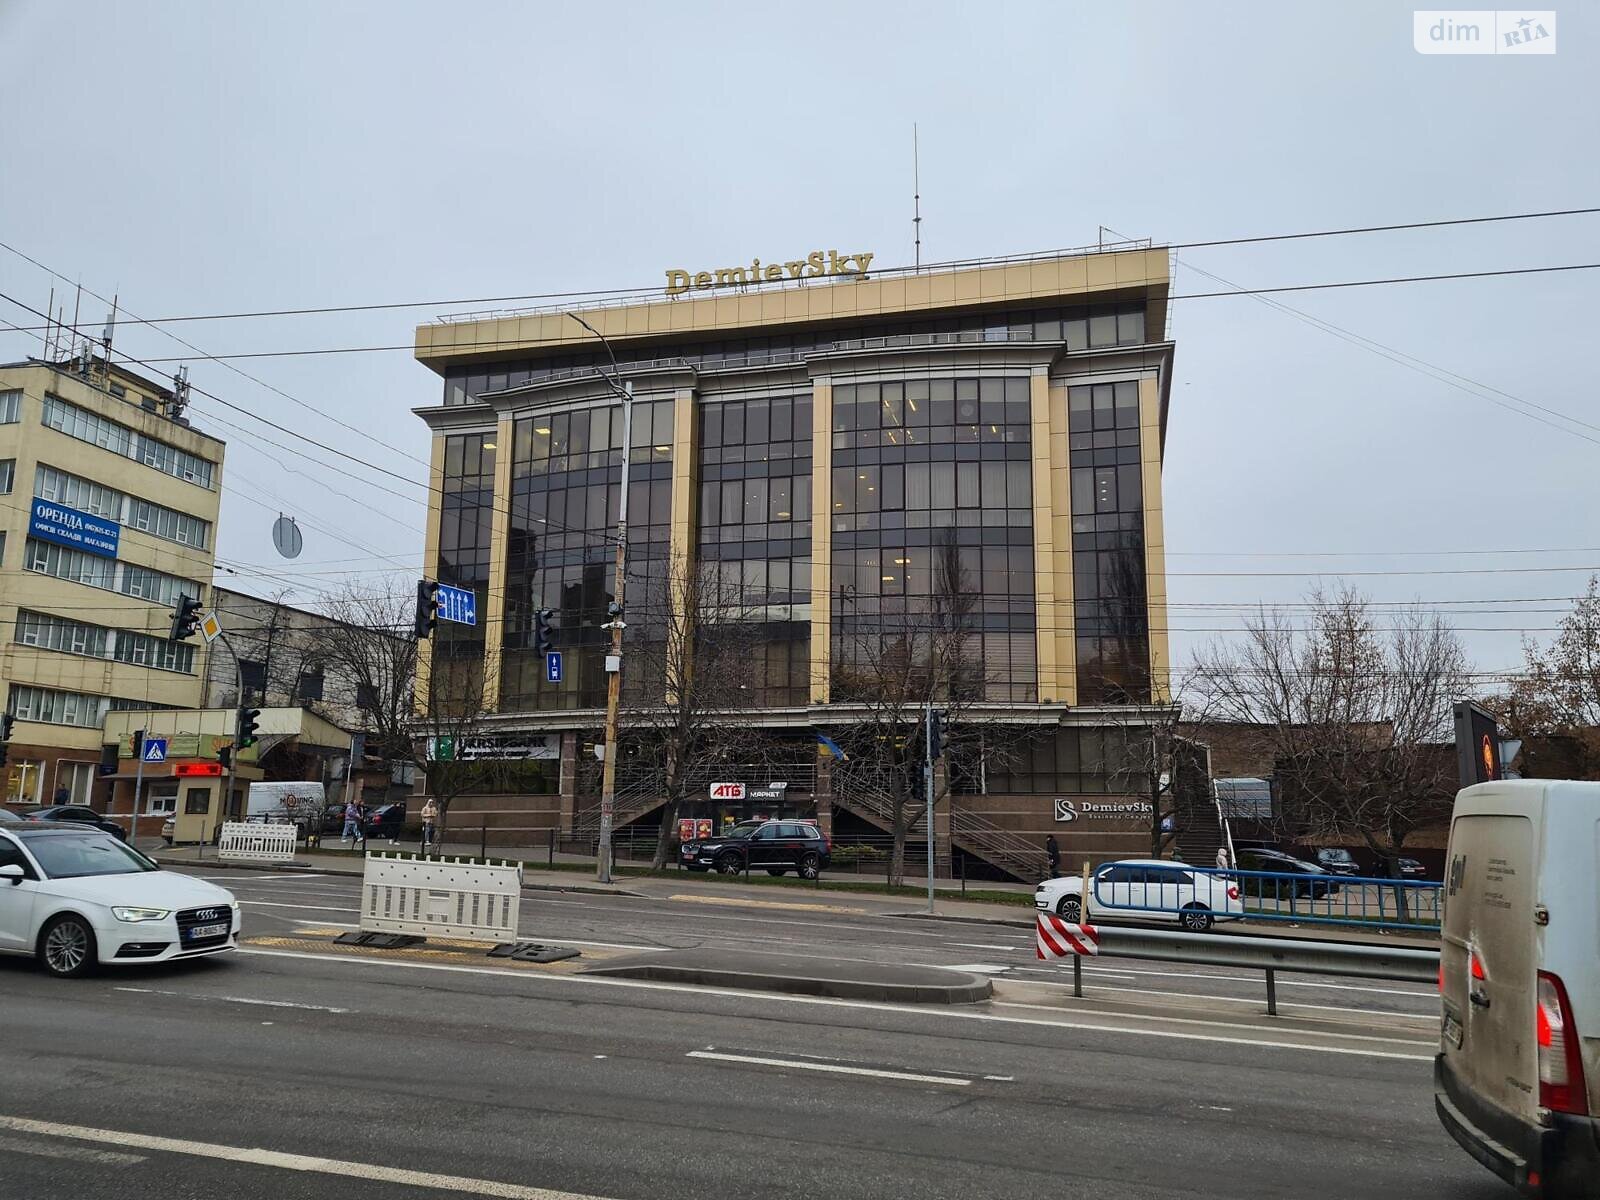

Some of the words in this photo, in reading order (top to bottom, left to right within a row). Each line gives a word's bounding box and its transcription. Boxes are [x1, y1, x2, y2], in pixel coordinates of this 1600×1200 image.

[665, 250, 874, 295] DemievSky
[36, 505, 83, 530] ОРЕНДА
[1081, 802, 1153, 815] DemievSky
